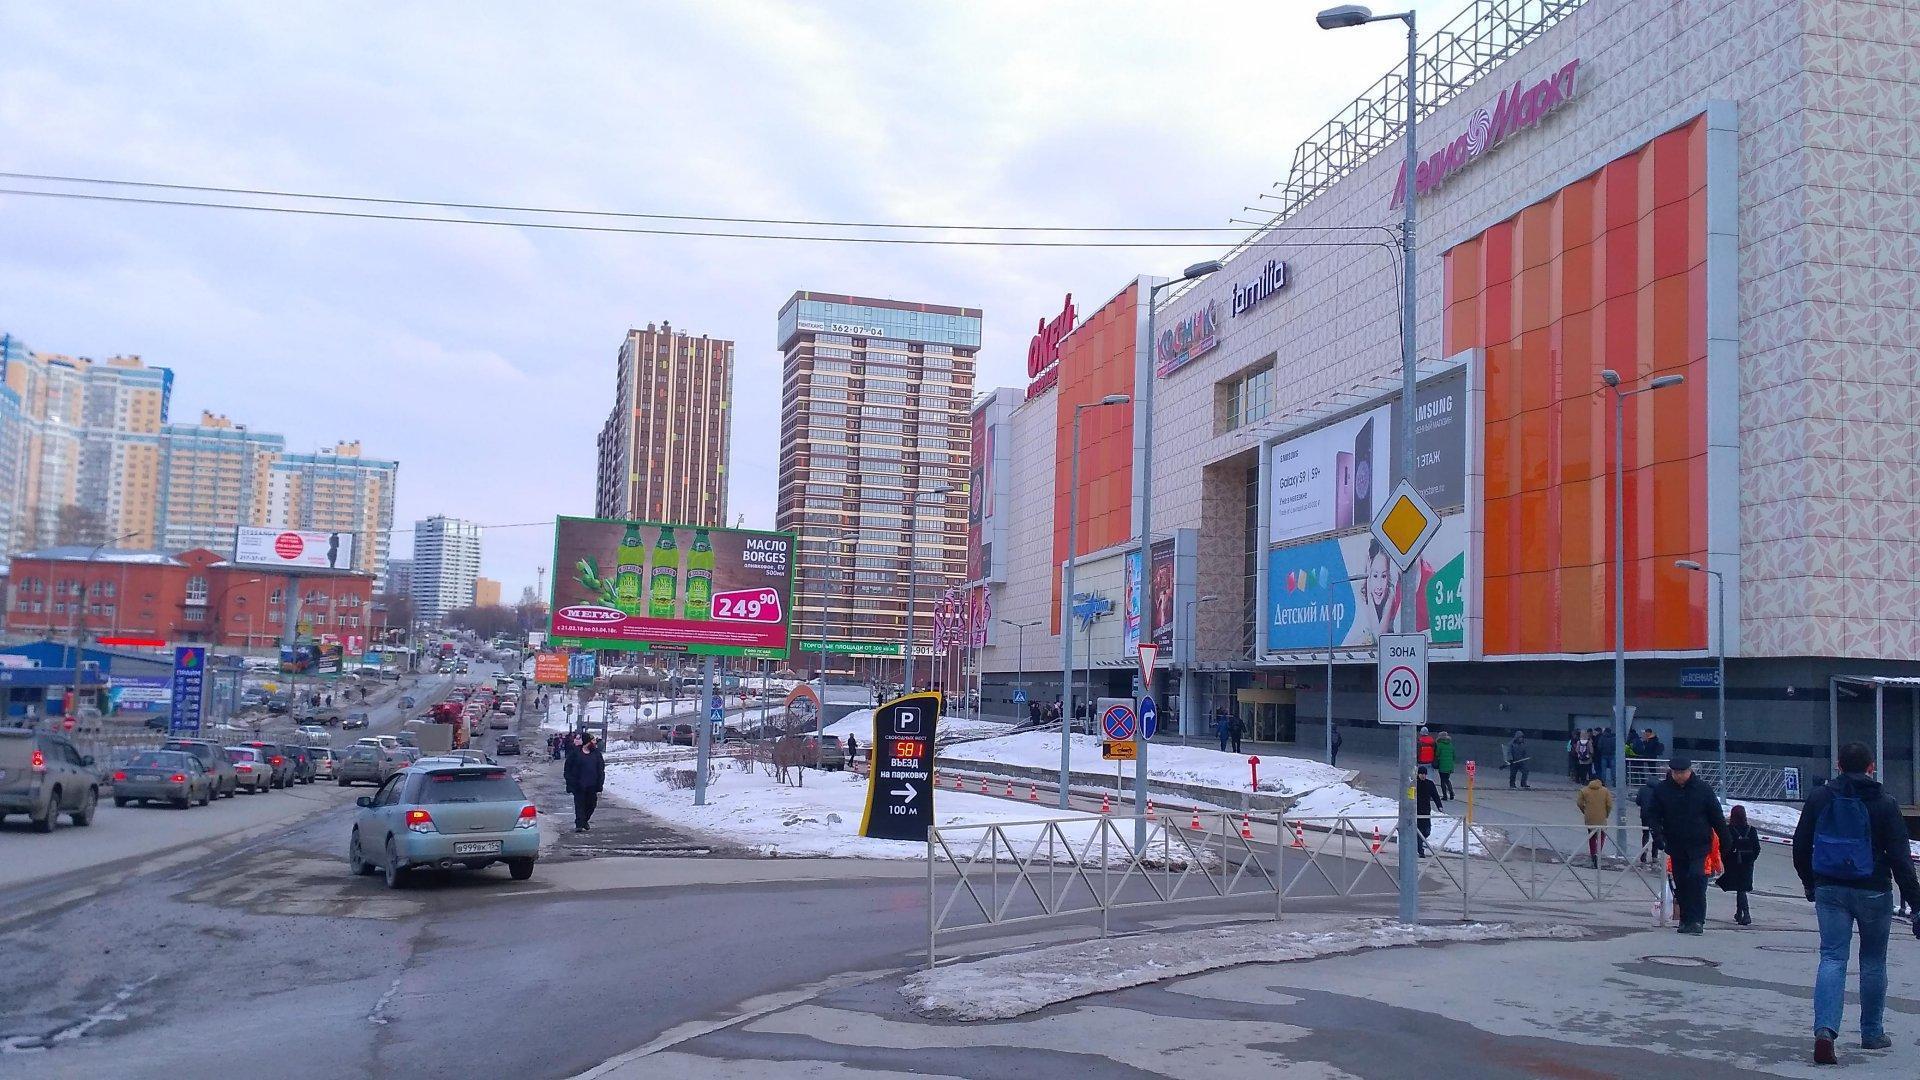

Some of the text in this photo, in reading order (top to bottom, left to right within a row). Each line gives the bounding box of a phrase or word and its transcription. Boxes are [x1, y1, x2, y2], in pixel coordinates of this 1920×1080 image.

[1232, 260, 1286, 318] familia
[832, 324, 882, 335] 362-07-04
[1416, 450, 1441, 468] 1 ЭТАЖ
[1279, 474, 1299, 489] Galaxy
[1299, 470, 1306, 484] S9
[746, 539, 787, 552] МАСЛО
[742, 550, 786, 564] BORGES
[1435, 579, 1444, 605] 3
[1446, 593, 1454, 604] и
[718, 593, 776, 618] 249 90
[566, 609, 621, 620] МЕГАС
[1273, 602, 1317, 626] Детский
[1389, 646, 1417, 658] ЗОНА
[1392, 679, 1412, 698] 20
[900, 711, 915, 730] P
[897, 742, 923, 757] 581
[890, 758, 919, 769] ВЪЕЗД
[880, 771, 928, 781] на парковку
[888, 805, 918, 815] 100 м
